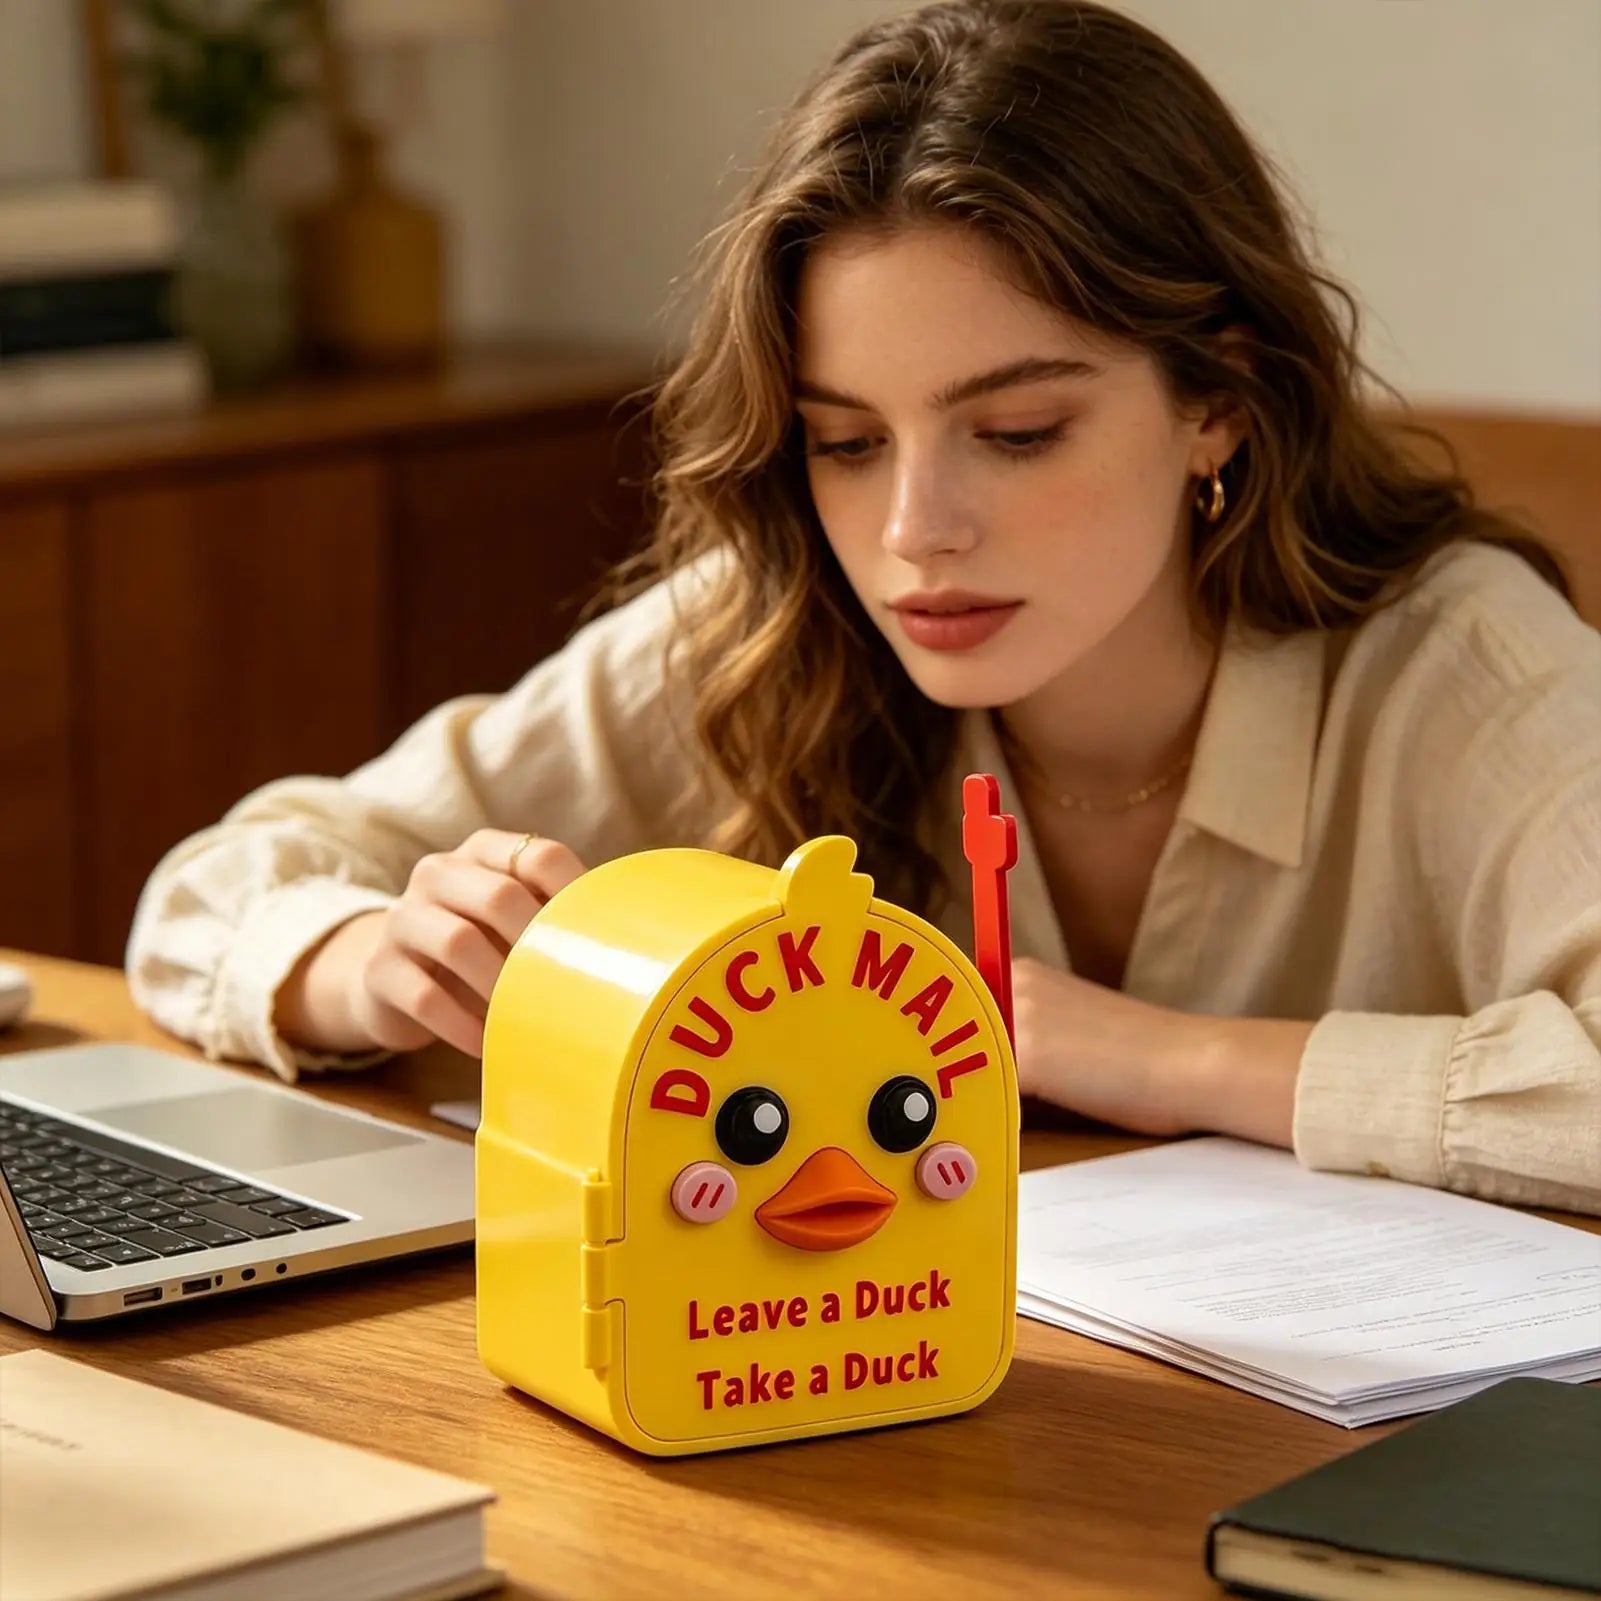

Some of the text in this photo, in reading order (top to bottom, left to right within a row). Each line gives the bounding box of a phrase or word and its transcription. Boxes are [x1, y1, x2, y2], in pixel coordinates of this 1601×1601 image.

[649, 926, 988, 1118] DUCK MAIL
[688, 1269, 951, 1341] Leave a Duck
[696, 1340, 939, 1410] Take a Duck
